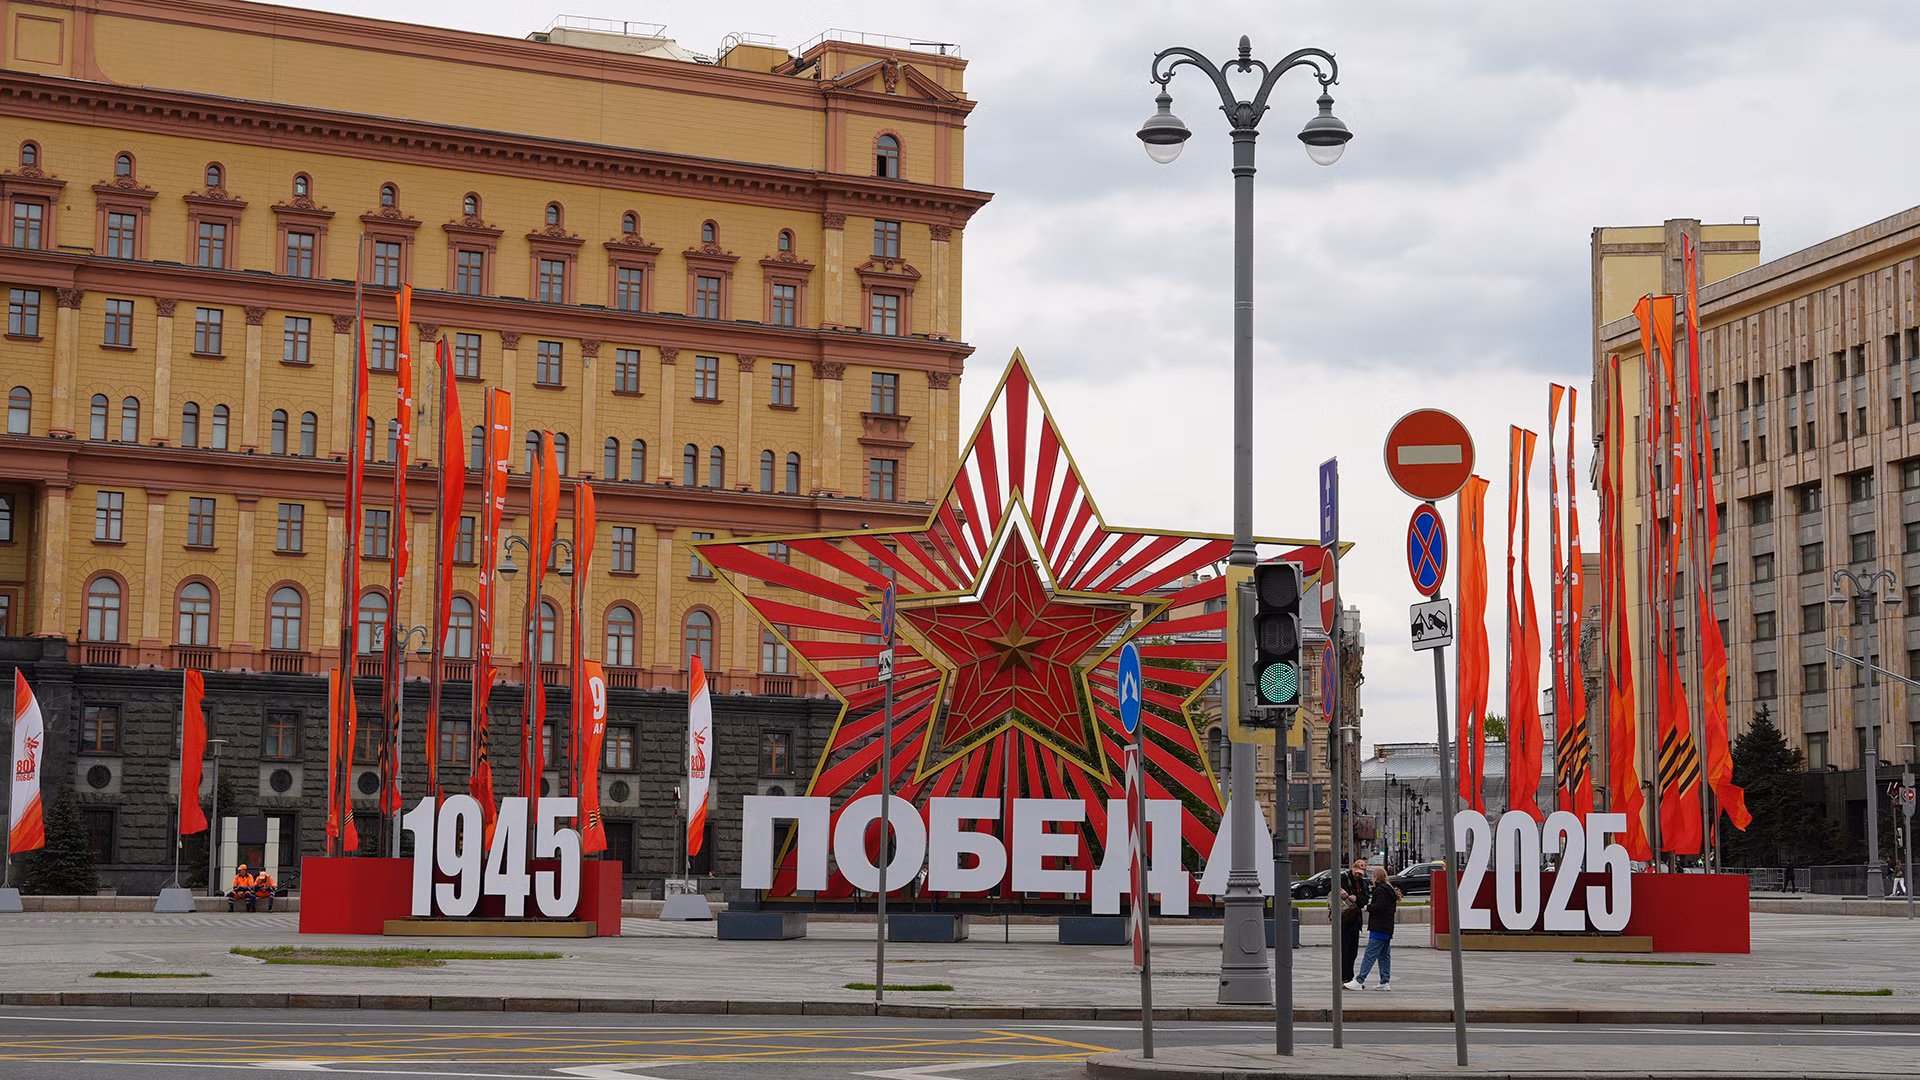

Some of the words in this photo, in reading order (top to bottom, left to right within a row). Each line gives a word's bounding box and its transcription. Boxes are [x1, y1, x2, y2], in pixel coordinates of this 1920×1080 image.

[589, 676, 605, 720] 9
[17, 760, 30, 773] 80
[402, 794, 581, 917] 1945
[740, 794, 1275, 916] ПОБЕДА
[1453, 809, 1632, 932] 2025
